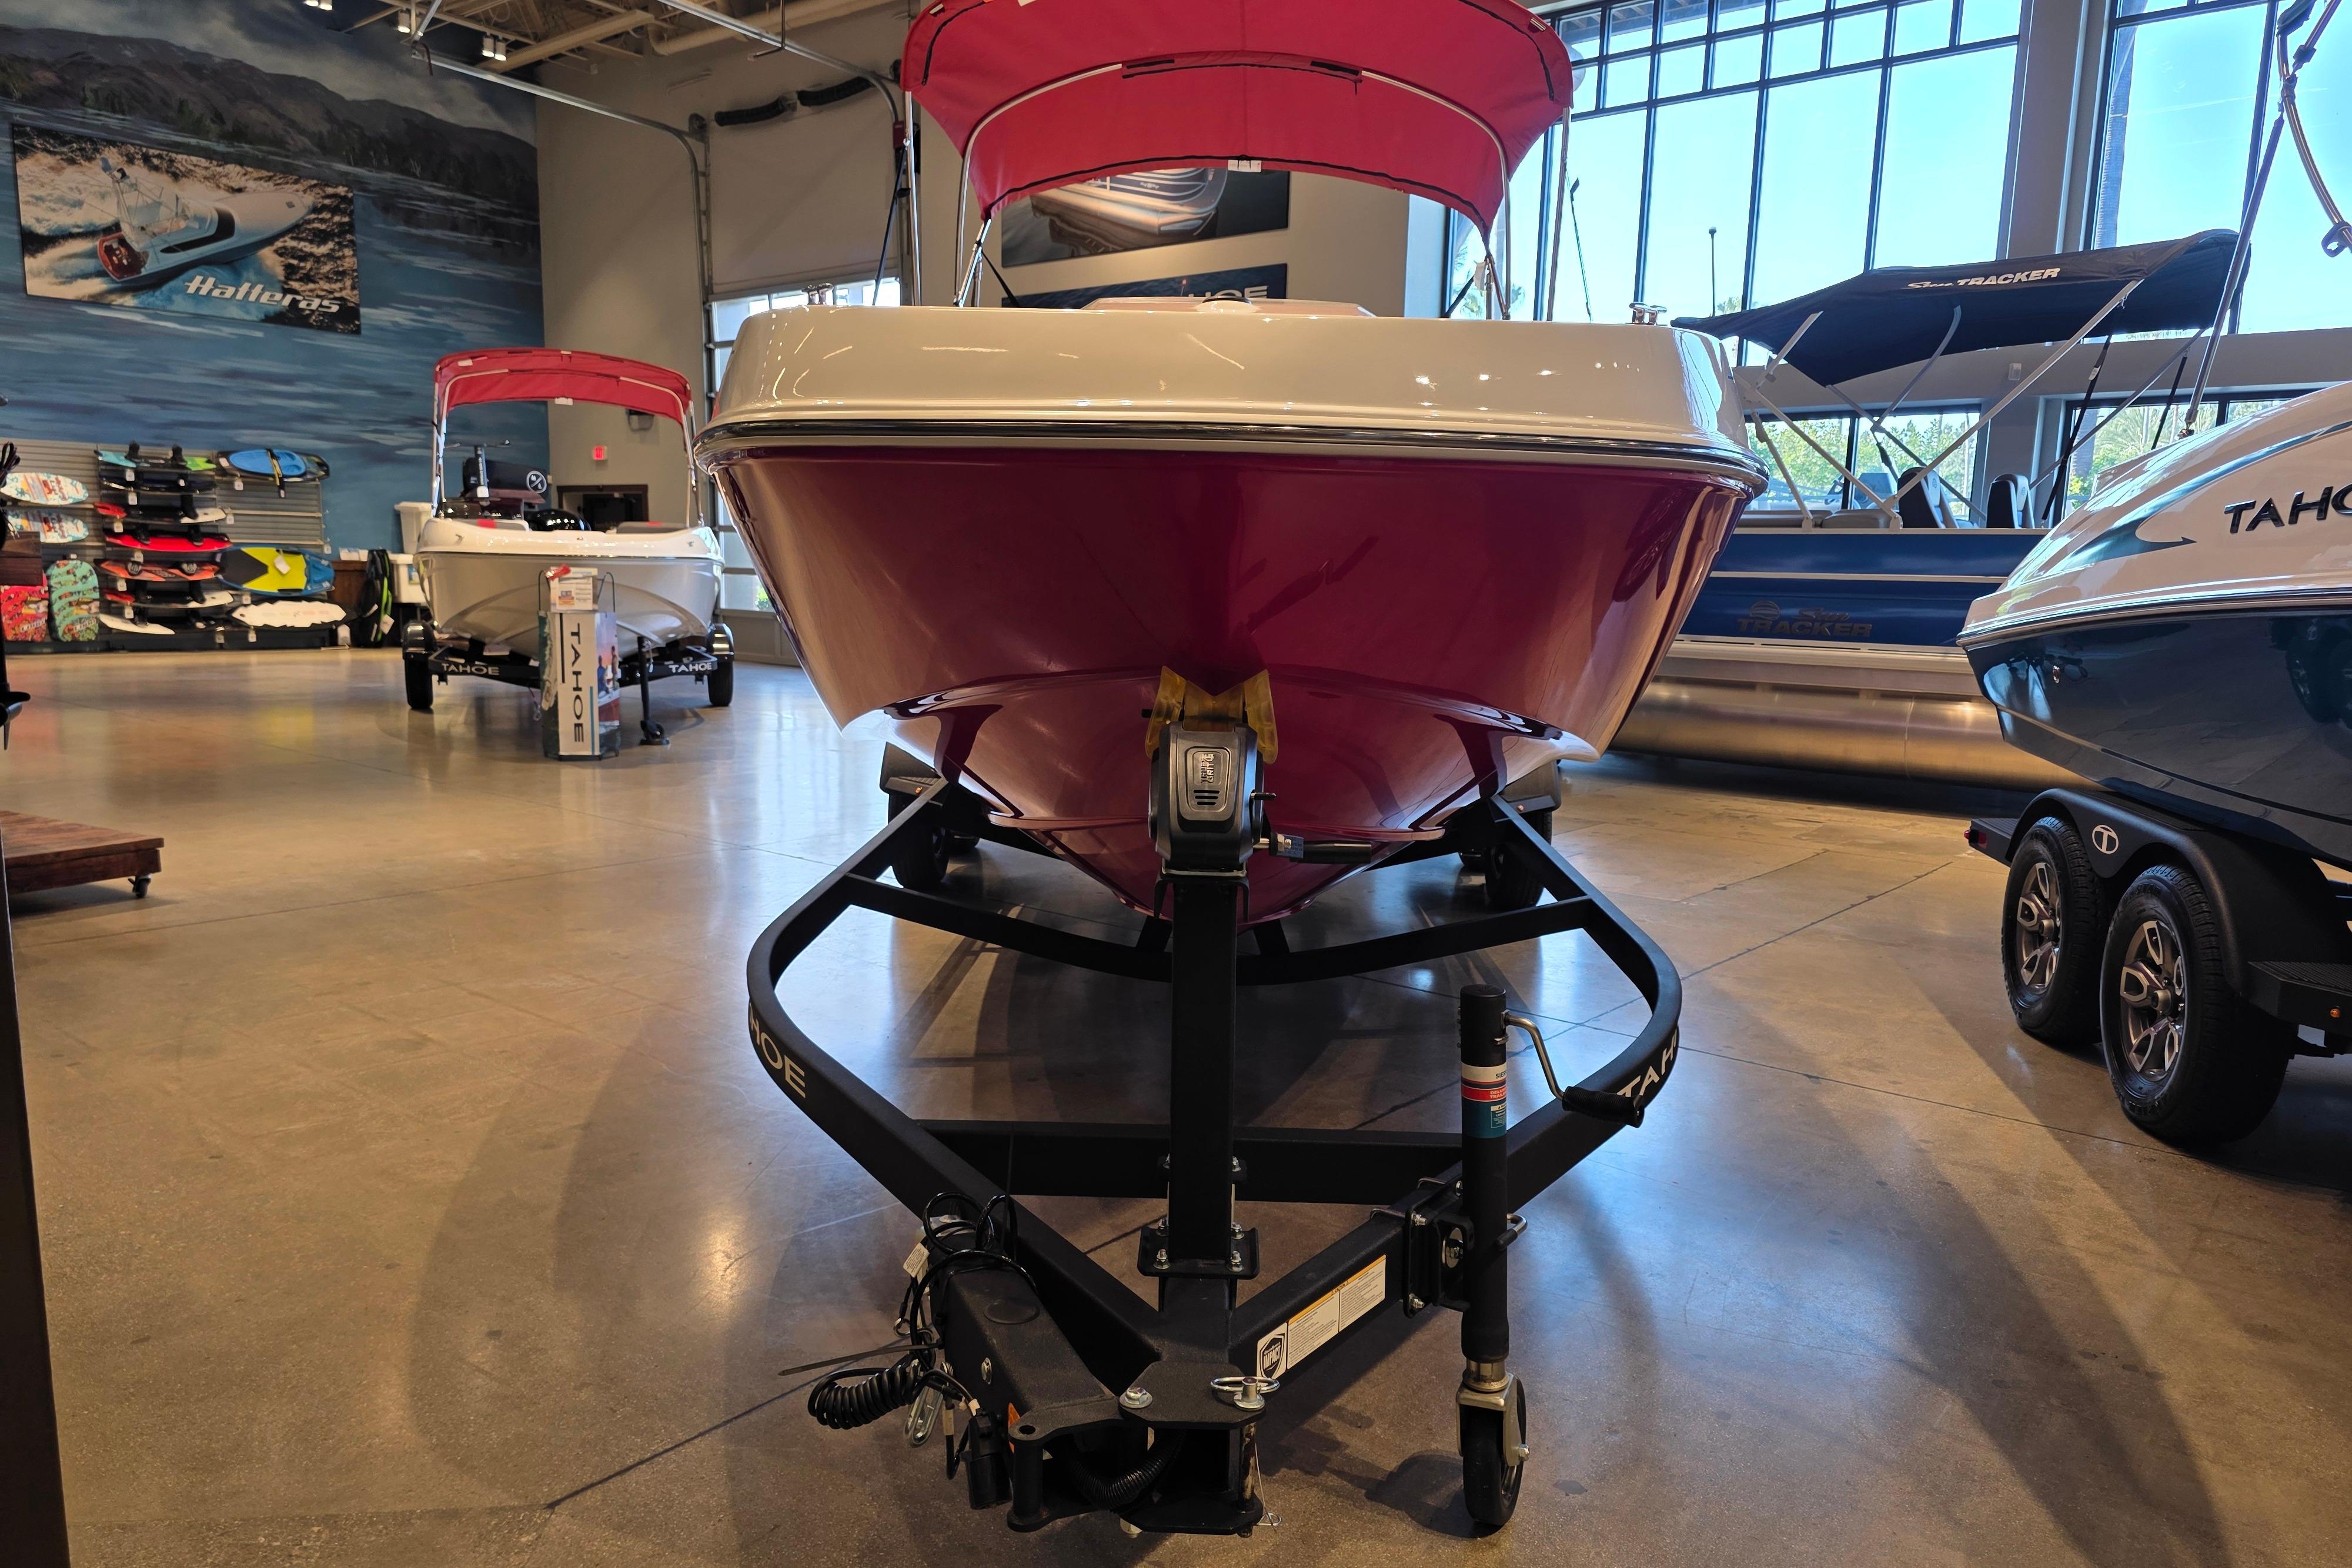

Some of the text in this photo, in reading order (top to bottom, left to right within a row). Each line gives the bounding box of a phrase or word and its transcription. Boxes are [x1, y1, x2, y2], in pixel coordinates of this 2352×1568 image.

[1957, 268, 2061, 286] TRACKER
[184, 275, 341, 313] Hatteras
[1737, 618, 1873, 637] TRACKER
[442, 663, 499, 676] TAHOE
[669, 663, 712, 673] TAHOE
[570, 623, 584, 743] TAHOE
[1617, 1029, 1678, 1098] TAH
[1264, 1345, 1281, 1370] IMPACT
